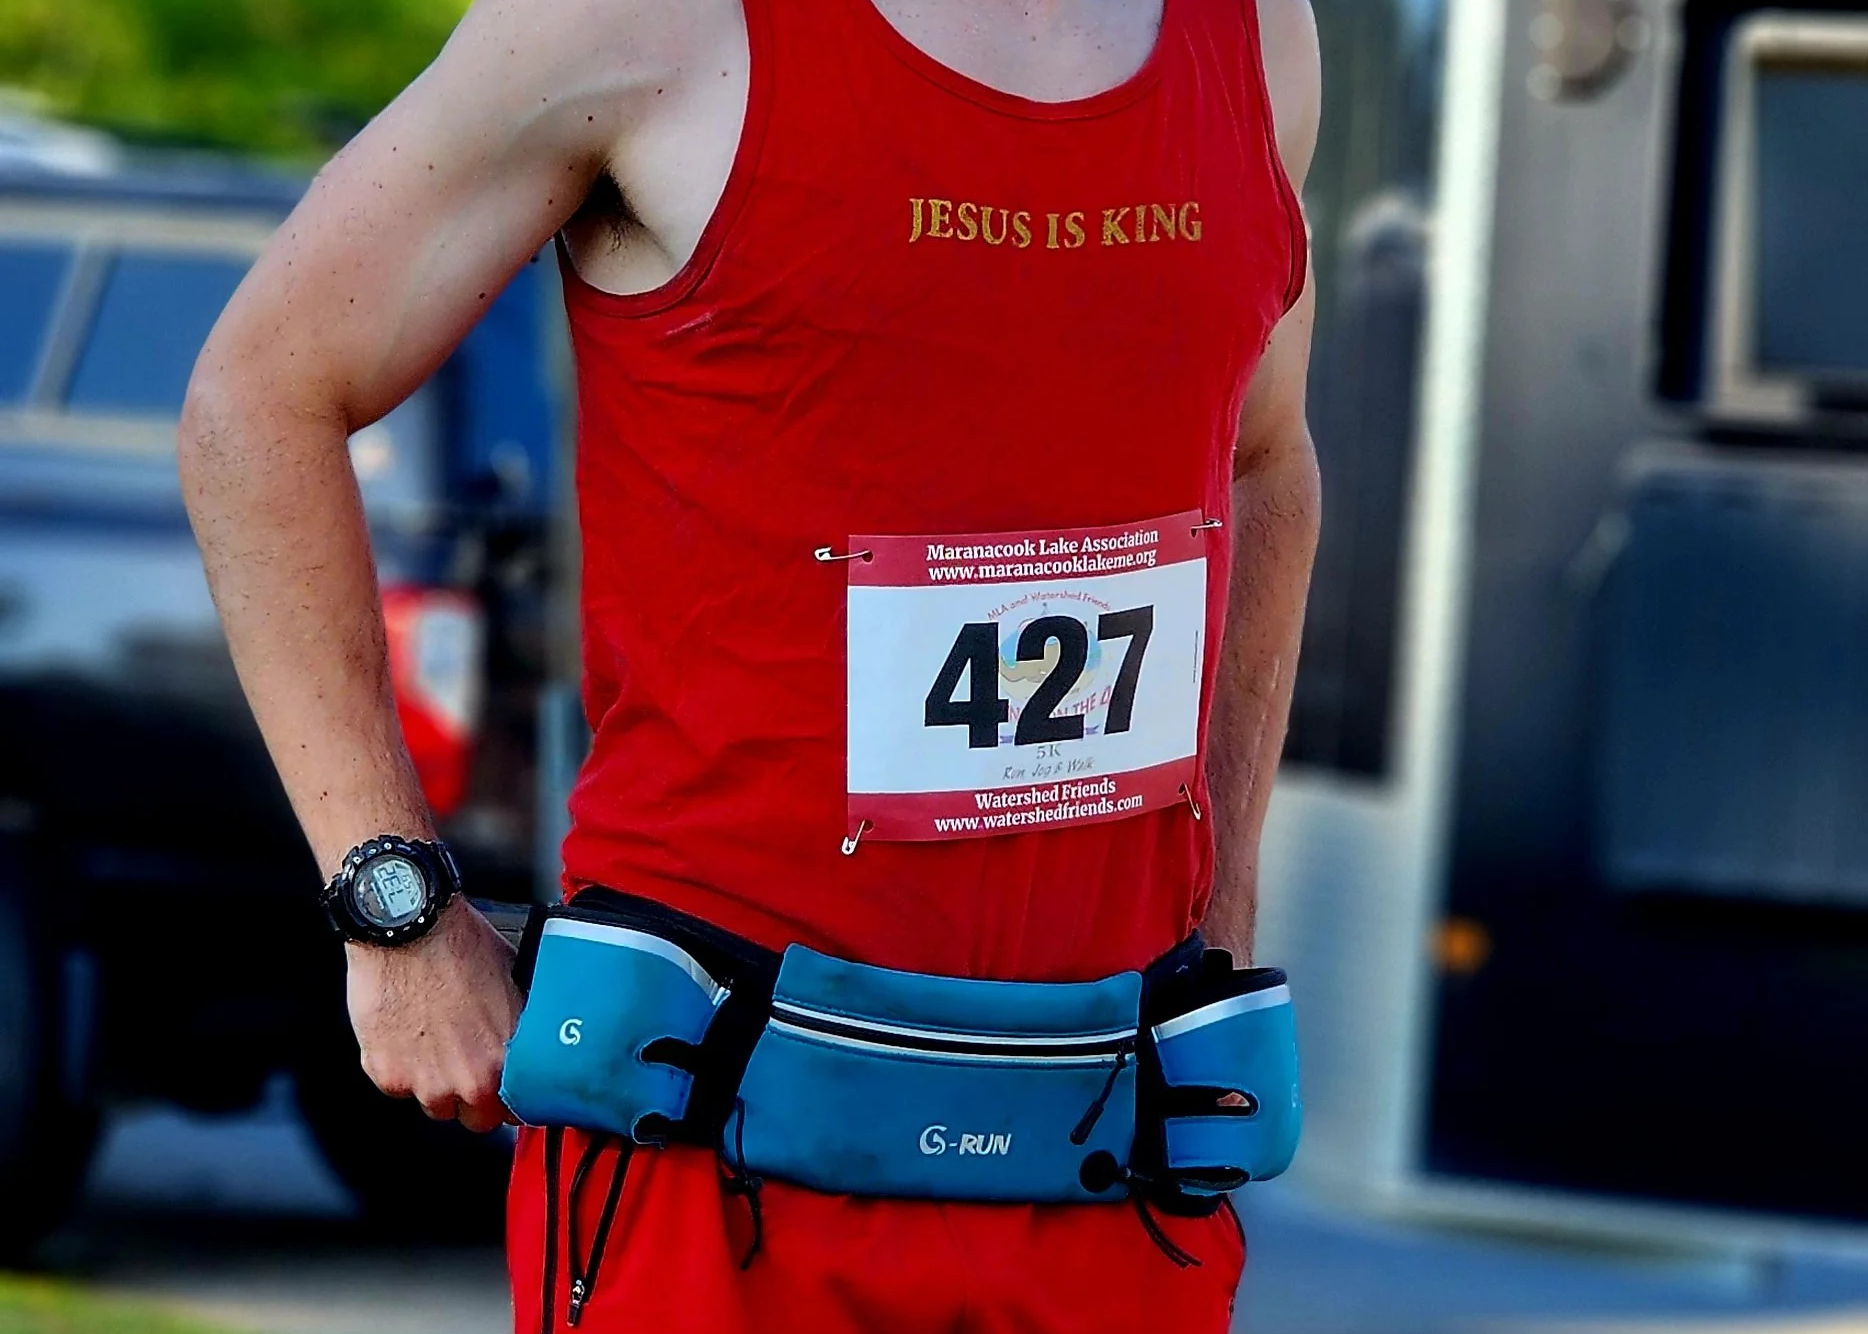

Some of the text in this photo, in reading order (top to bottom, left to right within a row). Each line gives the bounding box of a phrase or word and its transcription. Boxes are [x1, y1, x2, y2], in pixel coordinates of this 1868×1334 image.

[909, 198, 1203, 249] JESUS IS KING
[925, 530, 1159, 561] Maranacook Lake Association
[928, 550, 1157, 581] www.maranacooklakeme.org
[987, 603, 1008, 620] MLA
[1010, 594, 1028, 609] and
[1031, 590, 1081, 602] Watershed
[924, 605, 1155, 749] 427
[1071, 692, 1096, 715] THE
[1036, 744, 1061, 759] 5K
[974, 777, 1116, 809] Watershed Friends
[934, 793, 1143, 832] www.watershedfriends.com
[920, 1125, 1012, 1155] G-RUN
